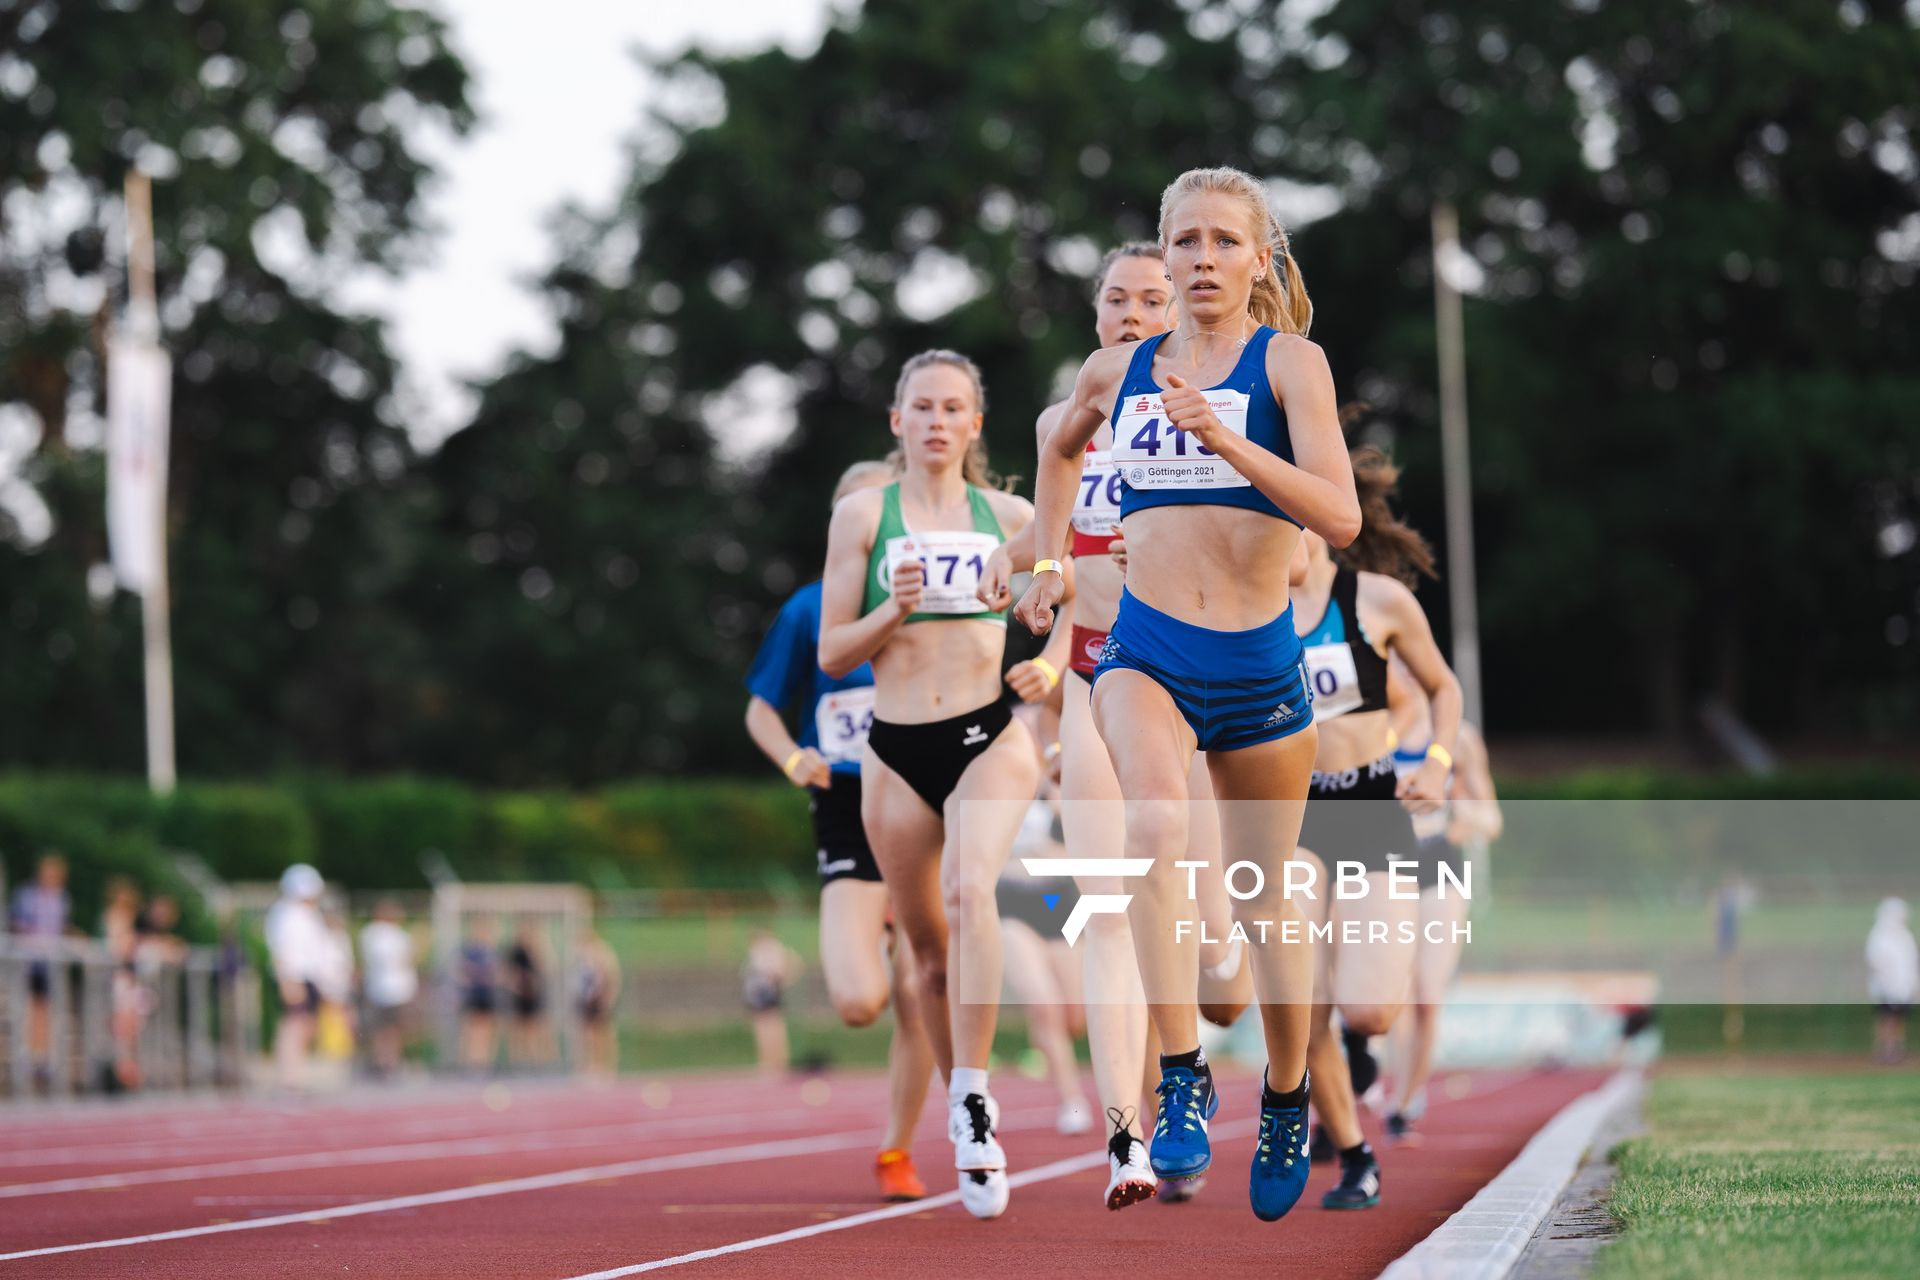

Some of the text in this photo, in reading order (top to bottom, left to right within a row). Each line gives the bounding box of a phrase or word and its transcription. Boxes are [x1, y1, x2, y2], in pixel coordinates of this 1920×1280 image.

[1130, 418, 1218, 456] 41
[1148, 466, 1215, 477] Göttingen 2021
